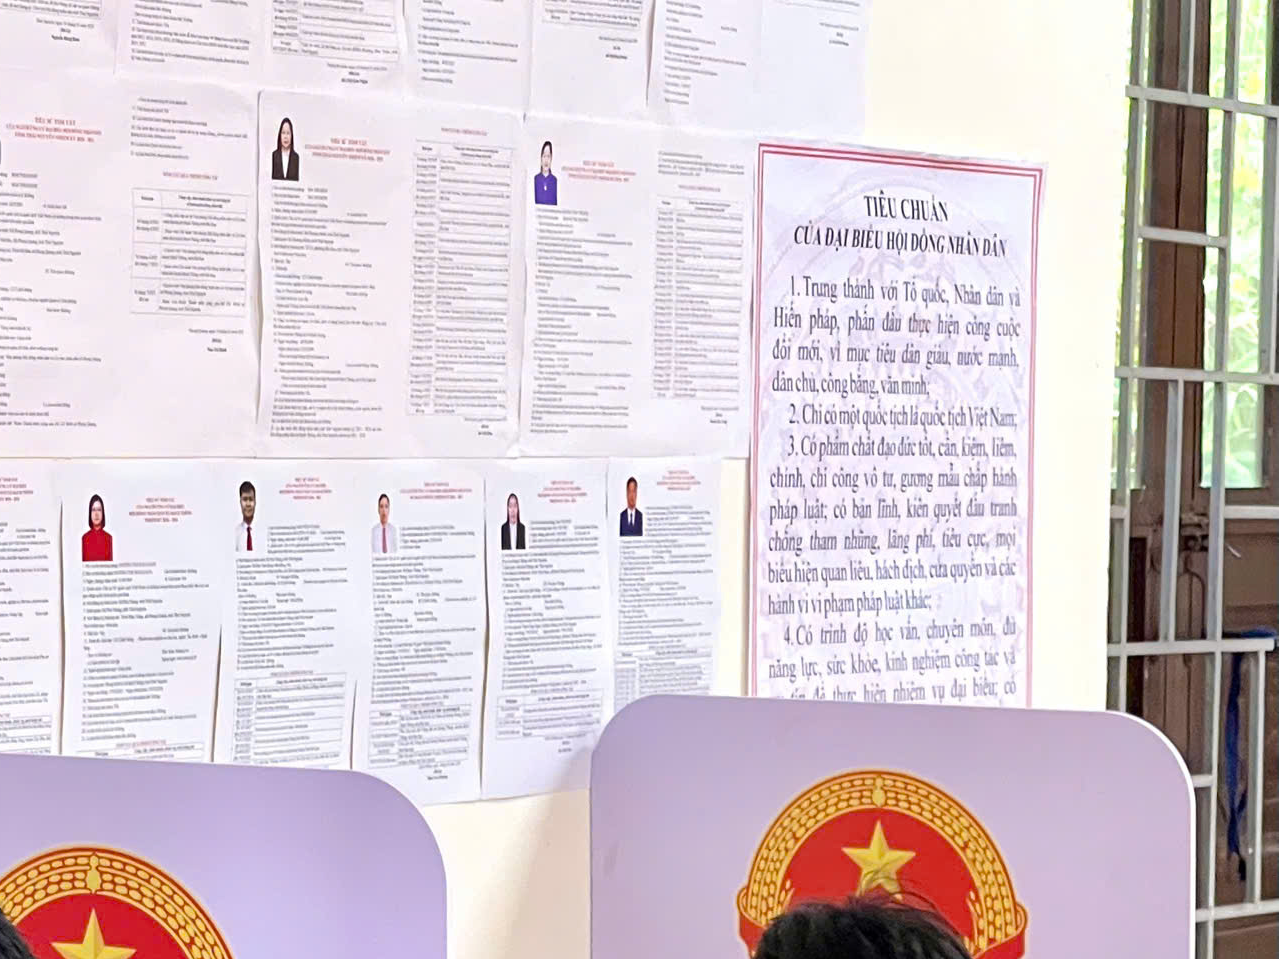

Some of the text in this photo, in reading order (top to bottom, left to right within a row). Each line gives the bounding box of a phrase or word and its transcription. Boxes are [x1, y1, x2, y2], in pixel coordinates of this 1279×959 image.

[864, 190, 949, 221] TIÊU CHUẨN
[794, 220, 1007, 257] CỦA ĐẠI BIỂU HỘI ĐỒNG NHÂN DÂN
[790, 276, 800, 297] 1.
[803, 276, 837, 303] Trung
[843, 278, 874, 300] thành
[881, 280, 898, 300] với
[904, 281, 917, 301] Tổ
[954, 283, 981, 306] Nhân
[986, 284, 1004, 306] dân
[1008, 287, 1021, 307] và
[774, 301, 1021, 342] Hiến pháp, phấn đấu thực hiện công cuộc
[772, 333, 791, 360] đổi
[798, 341, 823, 362] mới,
[829, 342, 841, 361] vì
[846, 347, 870, 367] mục
[876, 342, 896, 364] tiêu
[902, 344, 920, 365] dân
[926, 346, 951, 370] giàu,
[957, 347, 982, 366] nước
[772, 370, 793, 392] dân
[795, 372, 819, 393] chủ,
[821, 374, 848, 399] công
[881, 378, 900, 395] văn
[789, 403, 800, 425] 2.
[802, 403, 822, 425] Chỉ
[824, 403, 837, 425] có
[839, 405, 860, 430] một
[862, 398, 888, 431] quốc
[889, 405, 908, 430] tịch
[909, 405, 919, 426] là
[919, 401, 945, 432] quốc
[947, 405, 966, 430] tịch
[968, 405, 987, 430] Việt
[787, 435, 798, 456] 3.
[801, 434, 817, 456] Có
[819, 430, 849, 461] phẩm
[852, 434, 875, 457] chất
[877, 437, 896, 460] đạo
[898, 436, 917, 457] đức
[770, 462, 1017, 493] chính, chí công vô tư, gương mẫu chấp hành
[770, 492, 1017, 525] pháp luật; có bản lĩnh, kiên quyết đấu tranh
[768, 526, 1016, 556] chống tham nhũng, lãng phí, tiêu cực, mọi
[768, 554, 1016, 588] biểu hiện quan liêu, hách dịch, cửa quyền và các
[768, 592, 795, 615] hành
[798, 594, 809, 614] vi
[811, 594, 822, 614] vi
[824, 592, 854, 618] phạm
[856, 592, 883, 617] pháp
[884, 590, 904, 613] luật
